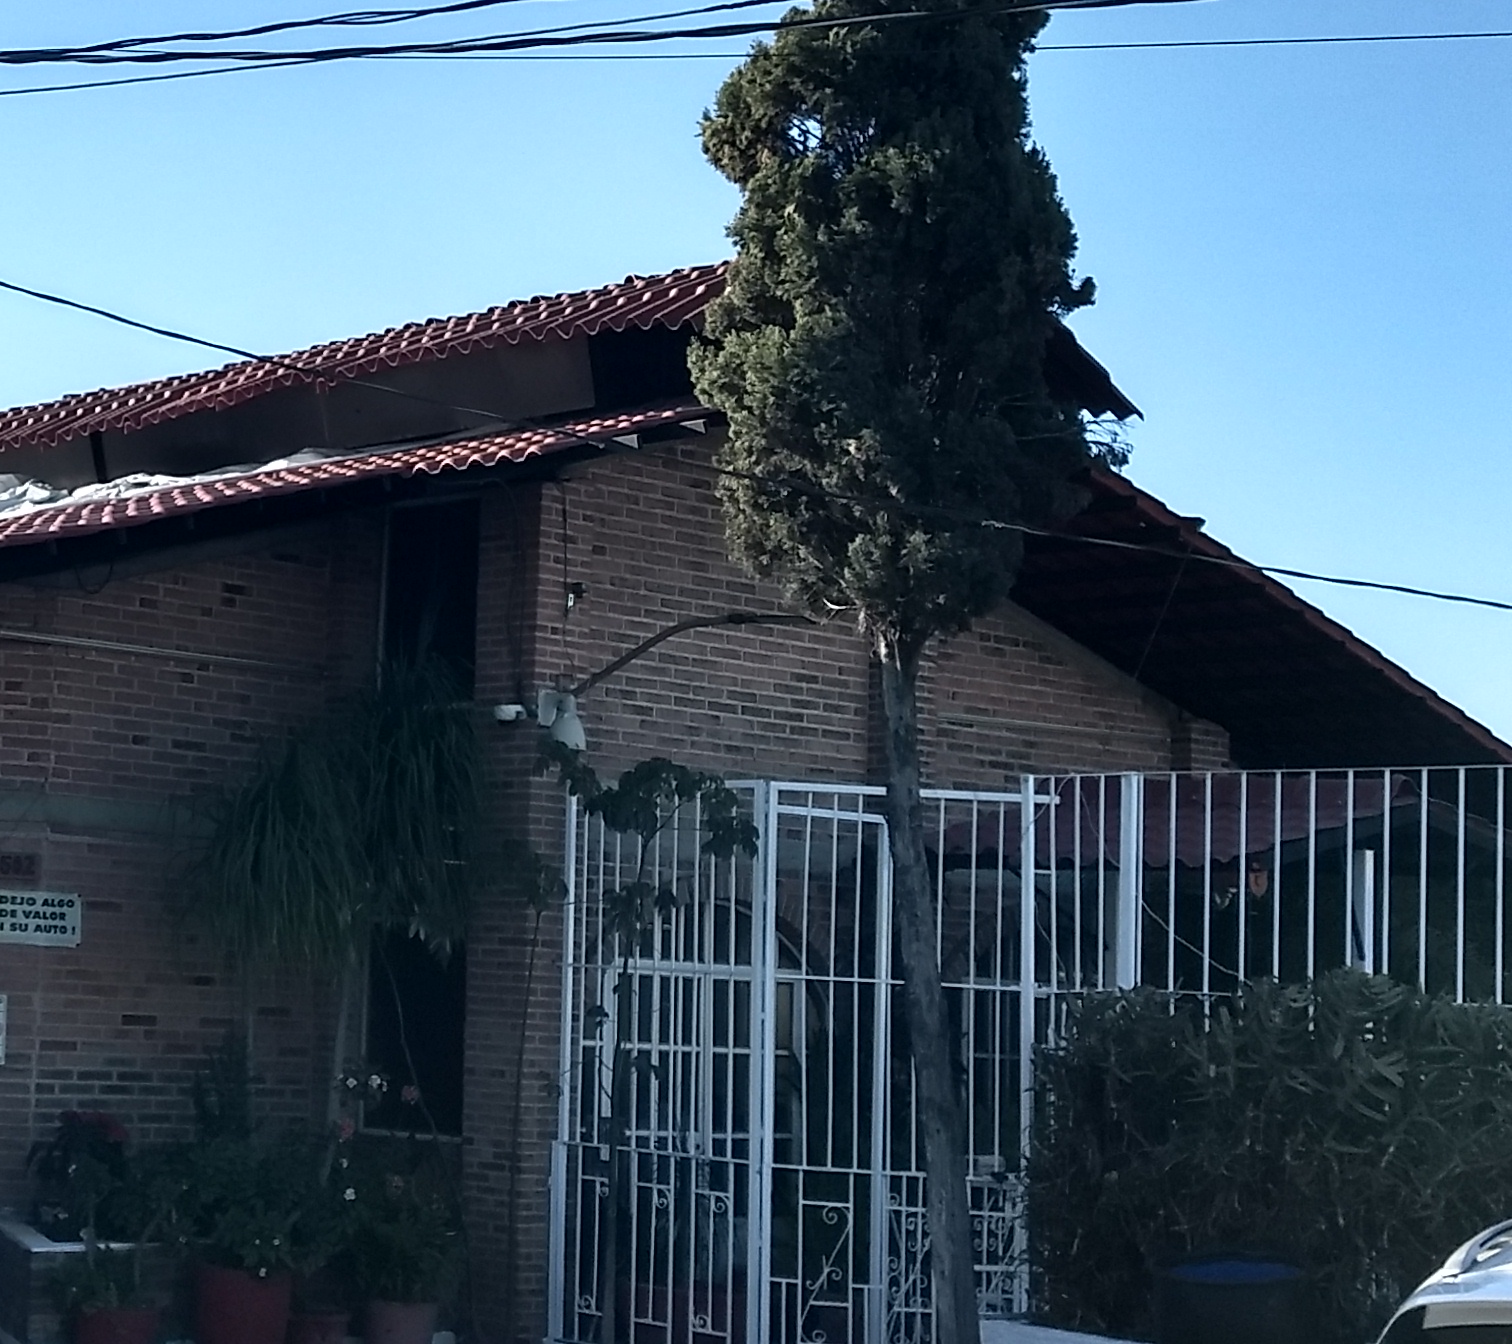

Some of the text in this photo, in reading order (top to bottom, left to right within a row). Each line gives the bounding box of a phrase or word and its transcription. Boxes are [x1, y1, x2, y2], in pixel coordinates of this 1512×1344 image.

[41, 898, 75, 909] ALGO
[22, 910, 67, 922] VALOR
[9, 922, 29, 933] SU
[33, 924, 68, 935] AUTO
